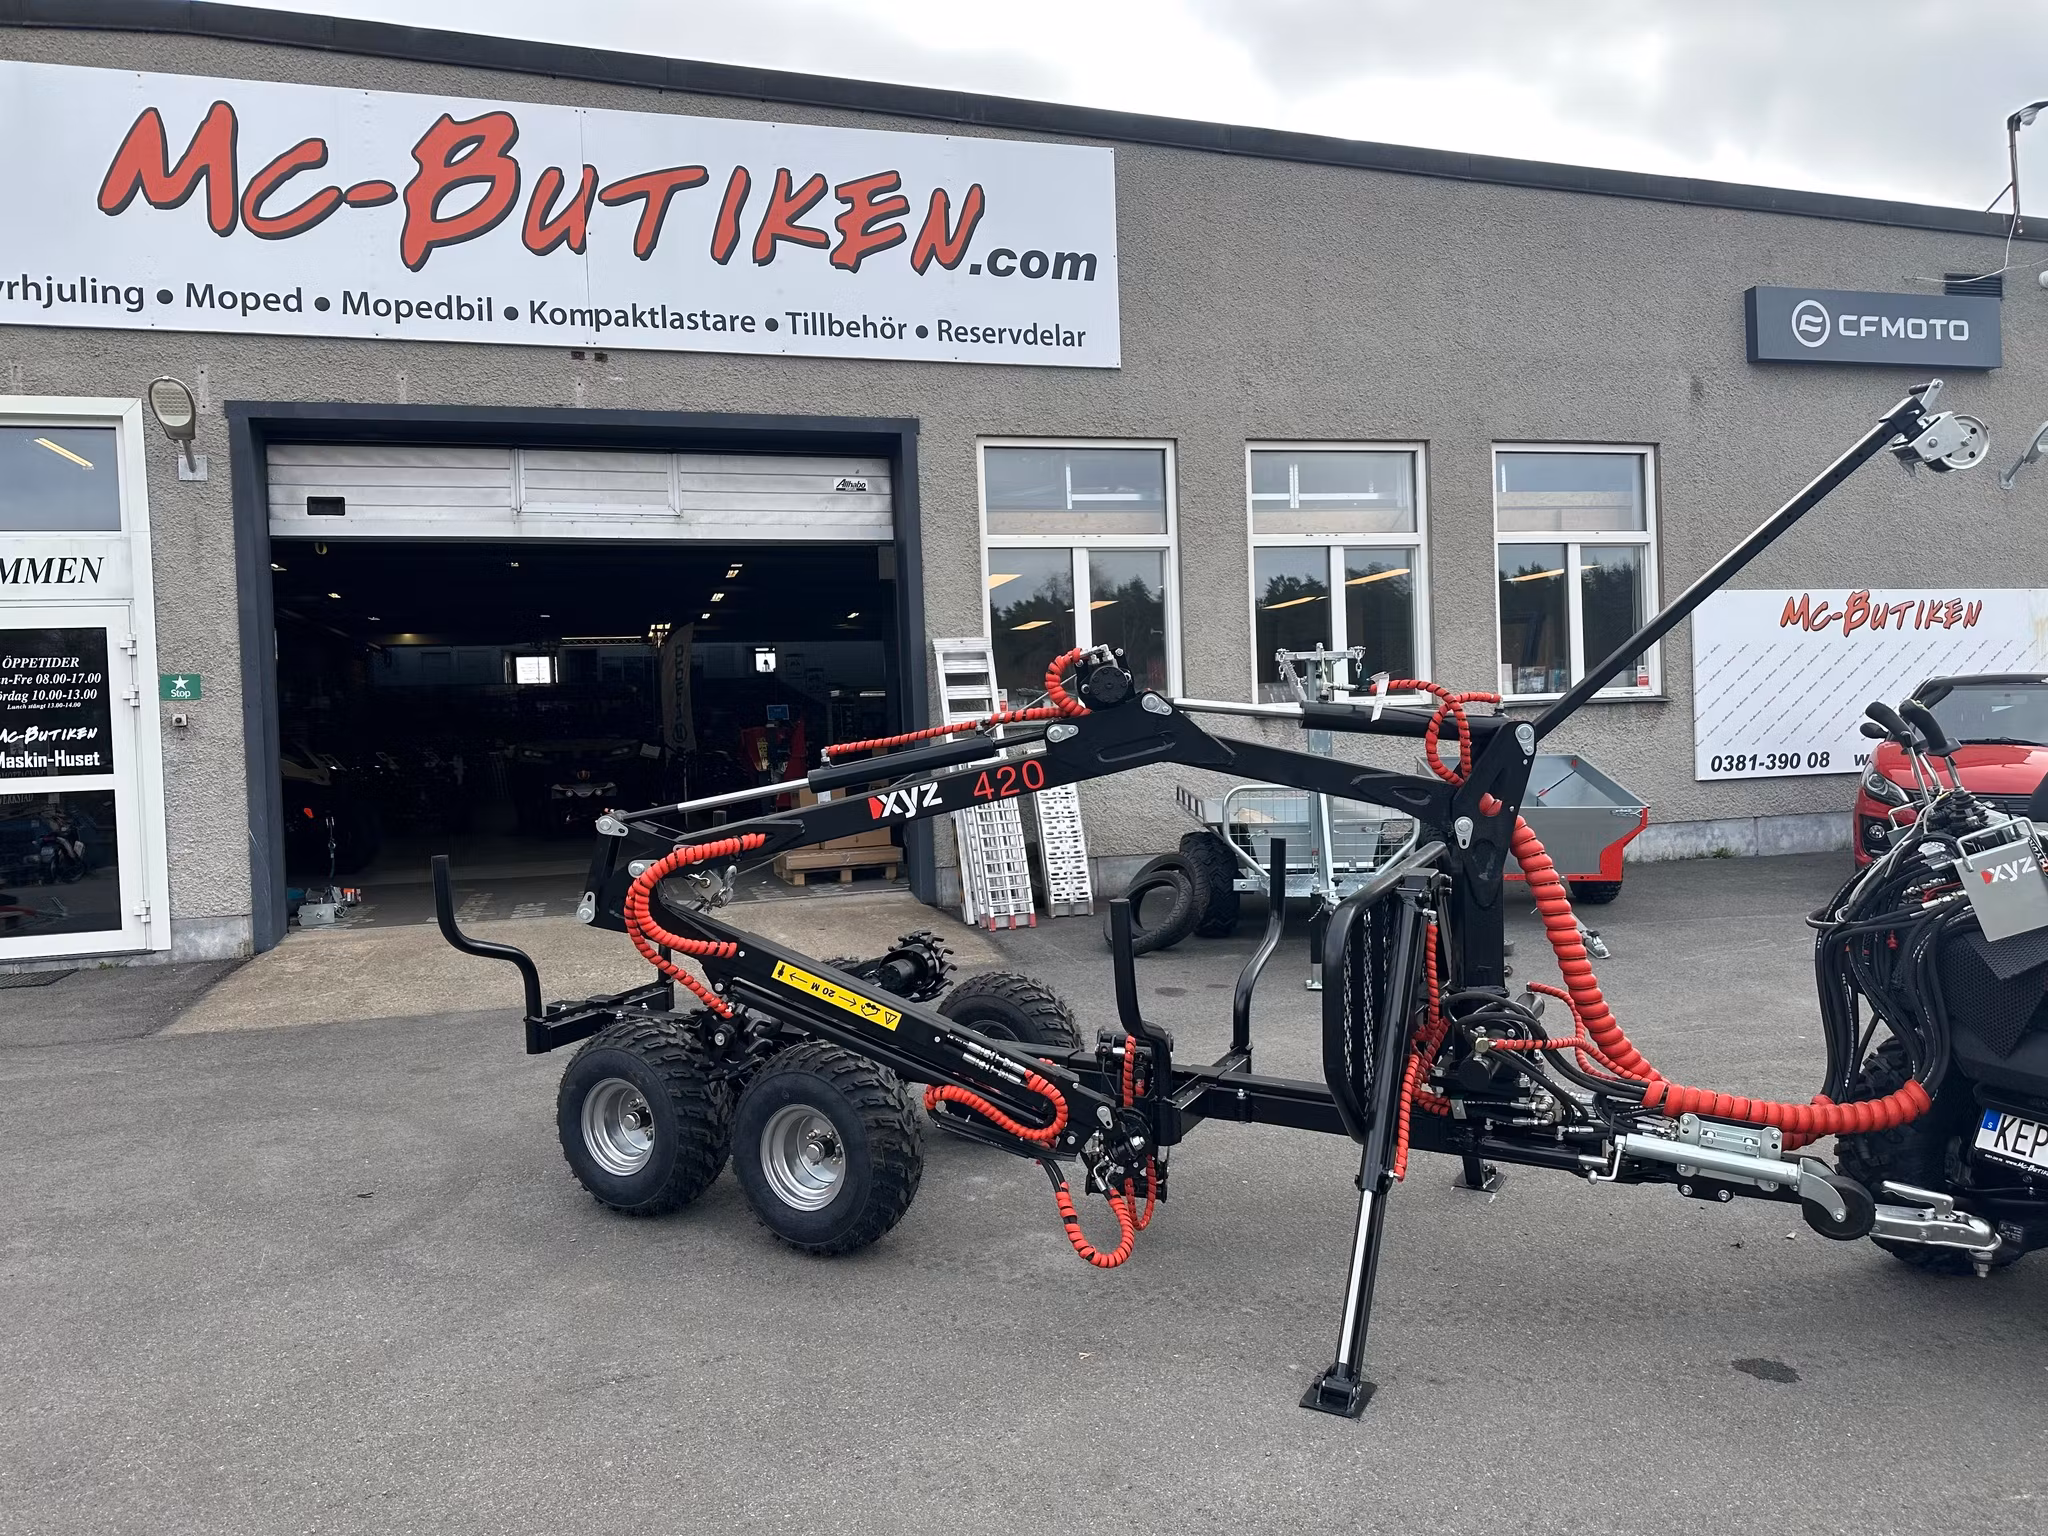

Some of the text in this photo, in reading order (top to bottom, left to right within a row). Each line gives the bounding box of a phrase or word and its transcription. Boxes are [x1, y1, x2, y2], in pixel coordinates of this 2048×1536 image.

[186, 281, 303, 316] Moped
[342, 290, 493, 324] Mopedbil
[529, 301, 756, 331] Kompaktlastare
[785, 311, 908, 340] Tillbehör
[937, 319, 1087, 347] Reservdelar
[1838, 314, 1970, 341] CFMOTO
[2, 655, 80, 669] ÖPPETIDER
[0, 672, 102, 685] n-Fre 08.00-17.00
[31, 688, 98, 701] 10.00-13.00
[170, 689, 191, 699] Stop
[28, 702, 46, 710] stängt
[1710, 752, 1801, 773] 0381-390
[1806, 751, 1831, 769] 08
[876, 759, 1045, 819] xyz 420
[1986, 855, 2038, 883] xyz
[811, 982, 836, 998] 20 M
[1987, 1114, 2048, 1158] S KEP
